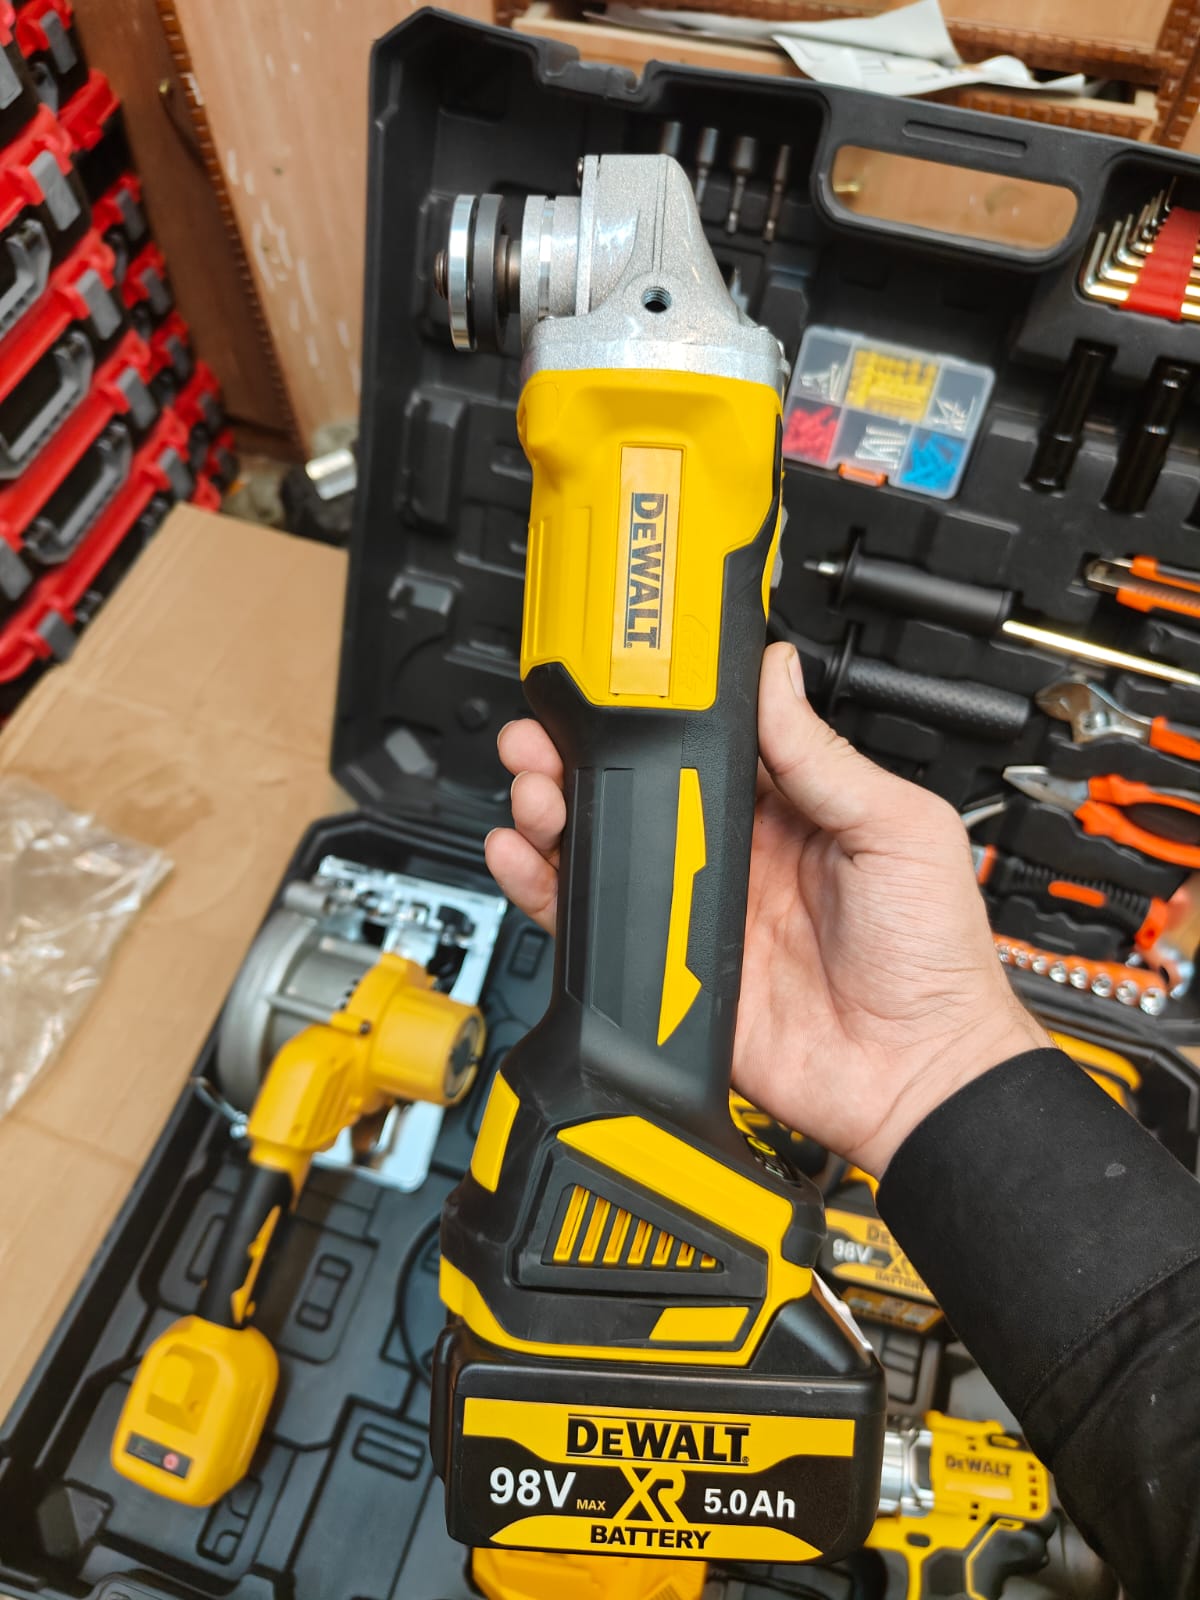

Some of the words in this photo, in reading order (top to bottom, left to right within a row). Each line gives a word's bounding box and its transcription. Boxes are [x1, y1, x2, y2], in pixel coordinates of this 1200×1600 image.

[833, 1239, 873, 1264] 98V
[489, 1467, 577, 1508] 98V
[576, 1499, 606, 1512] MAX
[613, 1466, 689, 1524] XR
[703, 1488, 797, 1519] 5.0Ah
[590, 1524, 712, 1550] BATTERY
